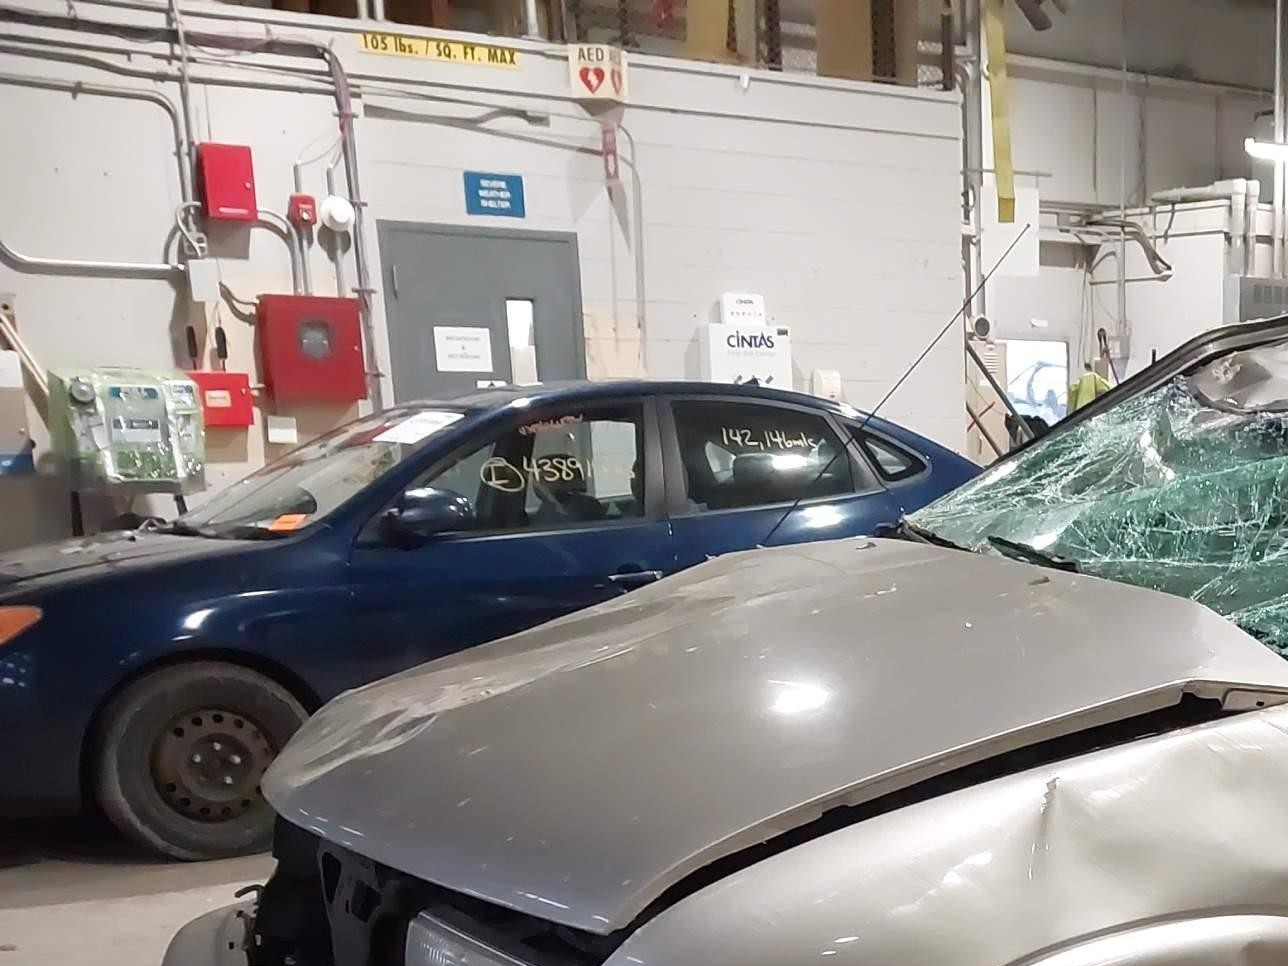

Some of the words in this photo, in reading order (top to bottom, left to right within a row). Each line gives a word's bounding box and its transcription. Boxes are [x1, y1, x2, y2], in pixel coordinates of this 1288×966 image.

[363, 33, 388, 50] 105
[394, 36, 419, 55] lbs.
[436, 41, 457, 60] SQ.
[463, 45, 482, 62] FT.
[487, 48, 517, 66] MAX
[578, 47, 604, 62] AED
